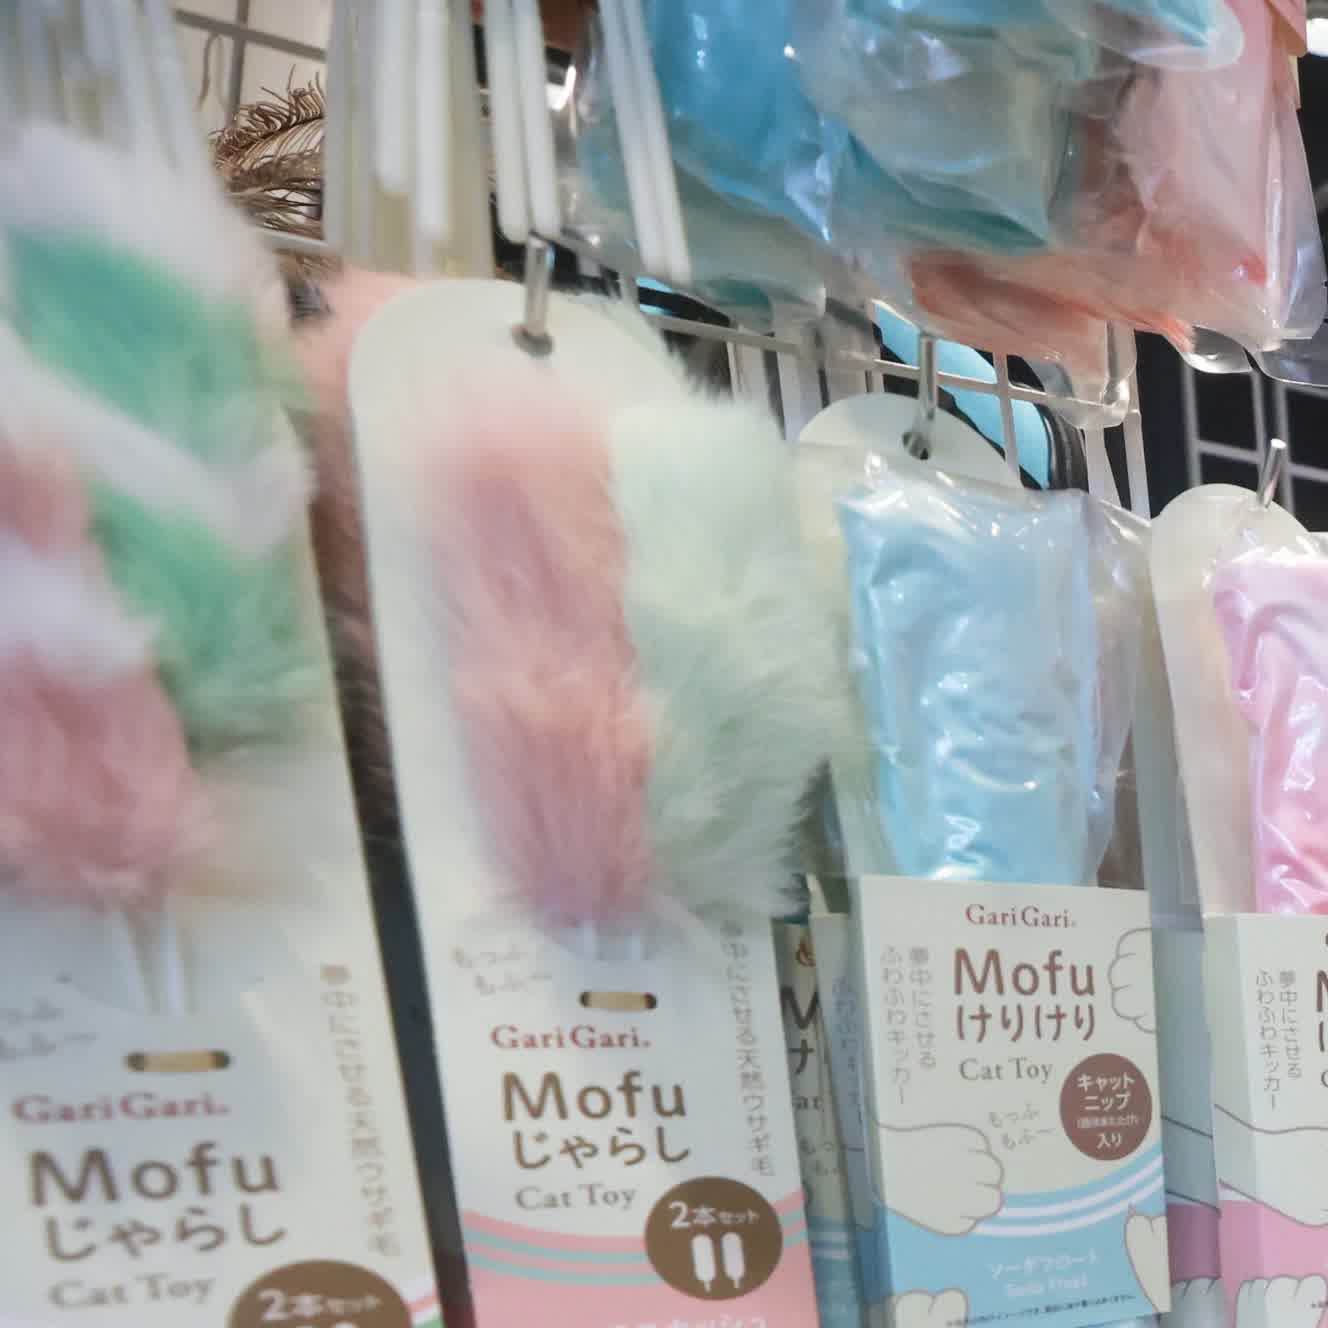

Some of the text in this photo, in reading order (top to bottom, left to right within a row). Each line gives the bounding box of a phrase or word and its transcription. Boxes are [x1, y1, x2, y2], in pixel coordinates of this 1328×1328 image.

[953, 947, 1097, 997] Mofu
[956, 1002, 1099, 1043] けりけり
[958, 1056, 1054, 1086] Cat Toy
[1077, 1073, 1135, 1091] キャット
[502, 1070, 688, 1122] Mofu
[1084, 1091, 1132, 1112] ニップ
[511, 1125, 690, 1170] じゃらし
[1096, 1132, 1123, 1150] 入り
[29, 1140, 282, 1207] Mofu
[514, 1182, 638, 1213] Cat Toy
[668, 1200, 761, 1230] 2本セット
[44, 1203, 288, 1262] じゃらし
[49, 1272, 217, 1311] Cat Toy
